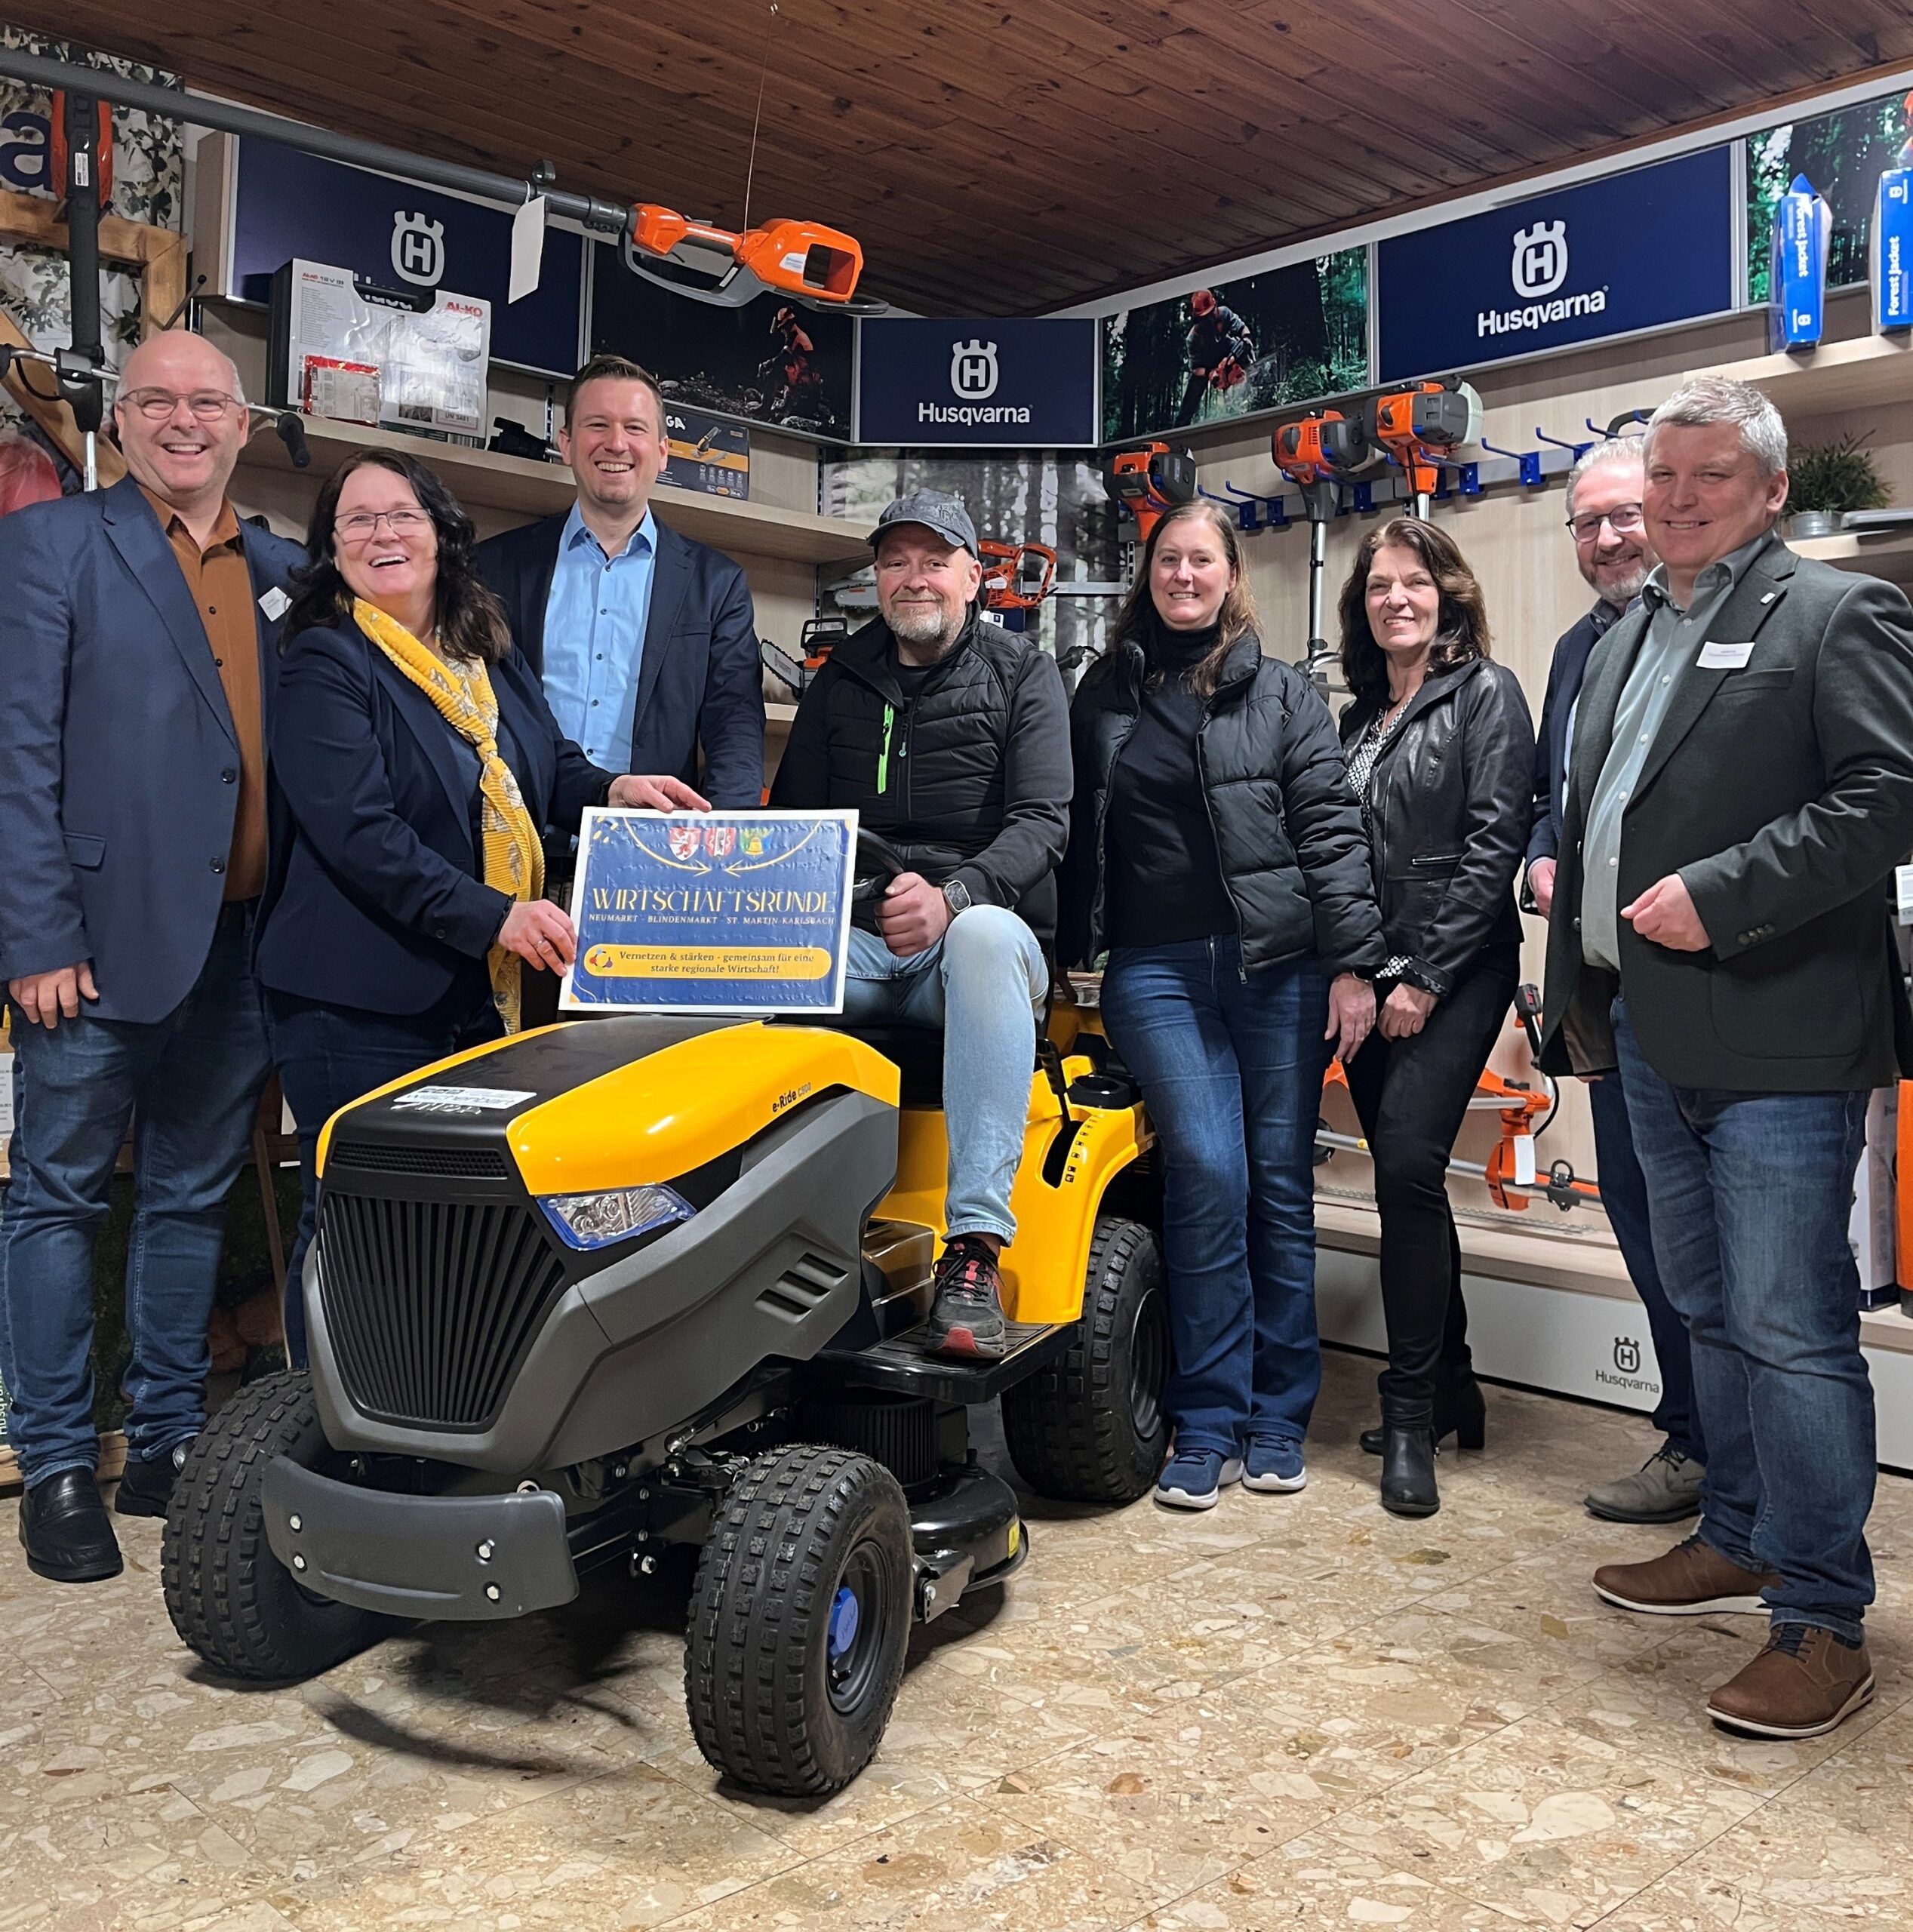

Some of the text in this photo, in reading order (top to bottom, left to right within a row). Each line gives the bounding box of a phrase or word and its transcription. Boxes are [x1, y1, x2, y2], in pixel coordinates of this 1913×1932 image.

[1887, 236, 1902, 315] Forest jacket
[1478, 290, 1606, 337] Husqvarna
[918, 402, 1031, 426] Husqvarna
[593, 888, 835, 912] WIRTSCHAFTSRUNDE
[589, 913, 638, 922] NEUMARKT
[647, 915, 717, 924] BLINDENMARKT
[743, 916, 778, 924] MARTIN
[782, 916, 835, 924] KARLSBACH
[620, 951, 666, 961] Vernetzen
[680, 952, 715, 961] stärken
[723, 954, 775, 964] gemeinsam
[778, 953, 791, 962] für
[794, 954, 814, 962] eine
[650, 964, 780, 974] starke regionale Wirtschaft!
[1595, 1370, 1659, 1393] Husqvarna
